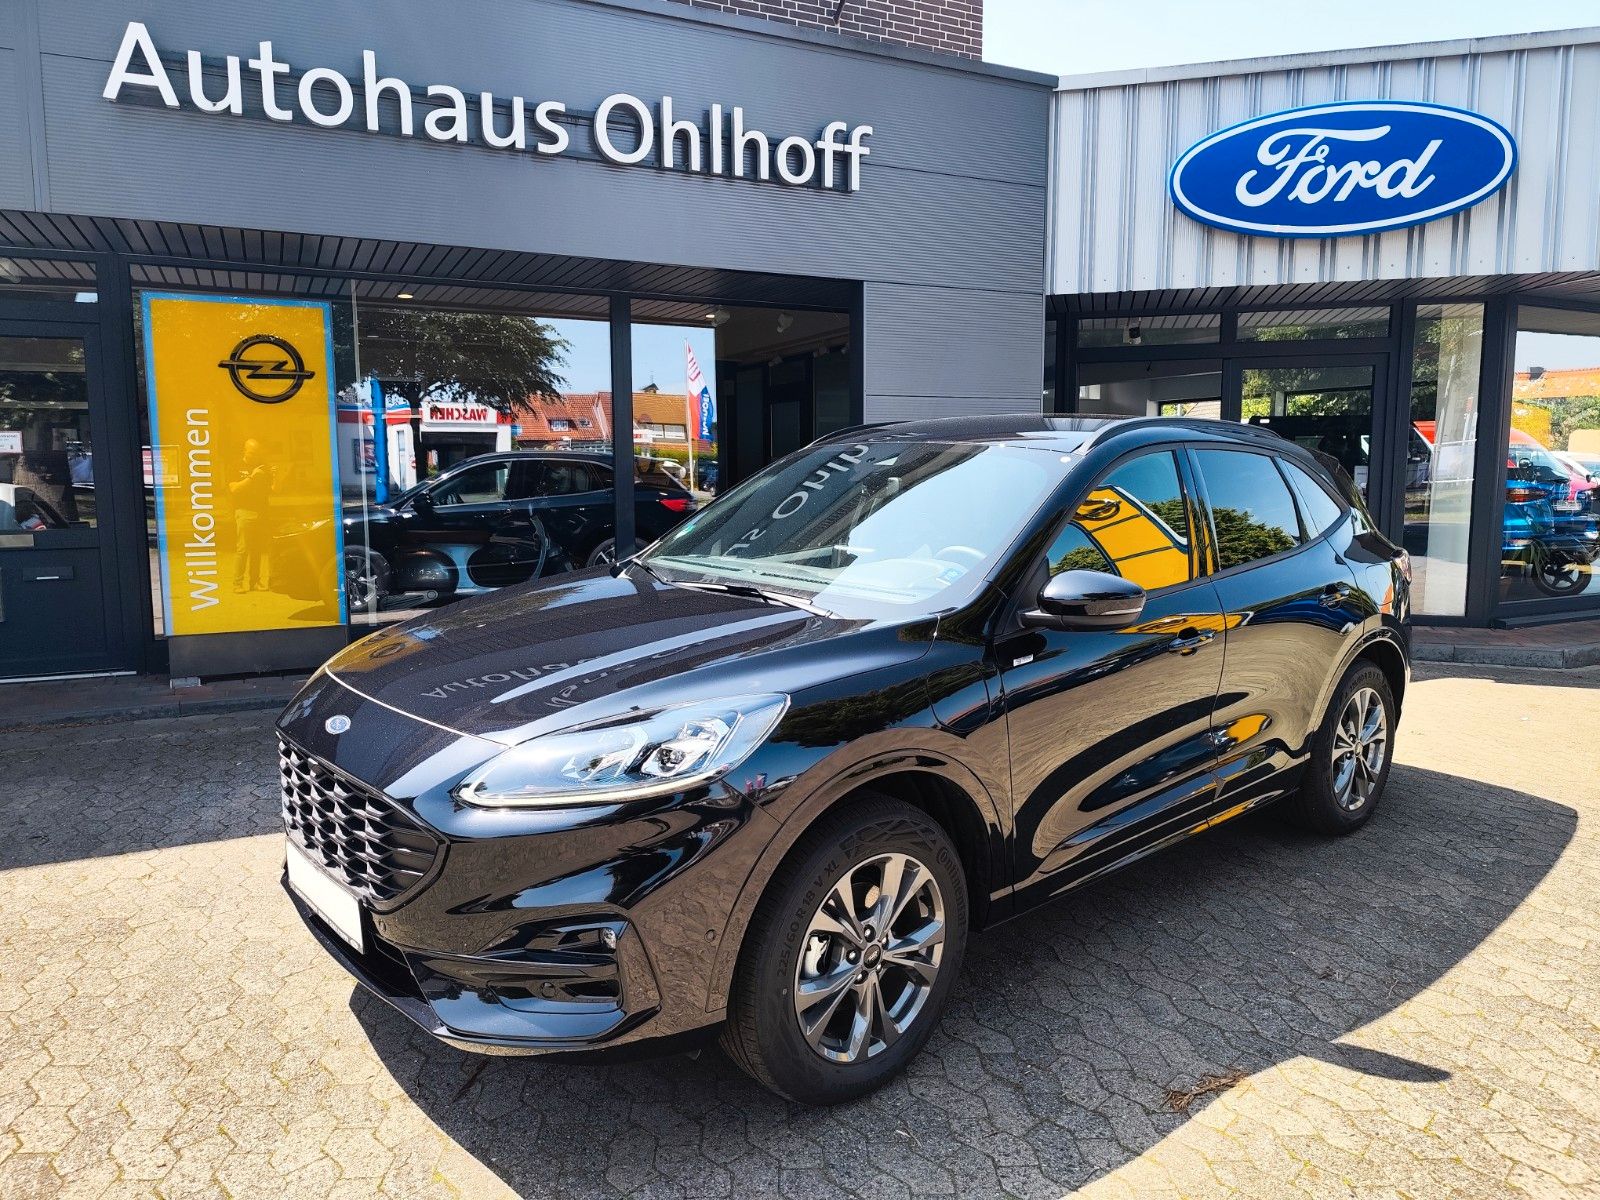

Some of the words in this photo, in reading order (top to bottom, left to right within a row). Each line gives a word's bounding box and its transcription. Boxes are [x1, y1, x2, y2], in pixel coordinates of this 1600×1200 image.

[103, 21, 571, 156] Autohaus
[593, 93, 873, 192] Ohlhoff
[1235, 125, 1443, 207] Ford
[184, 408, 220, 612] Willkommen
